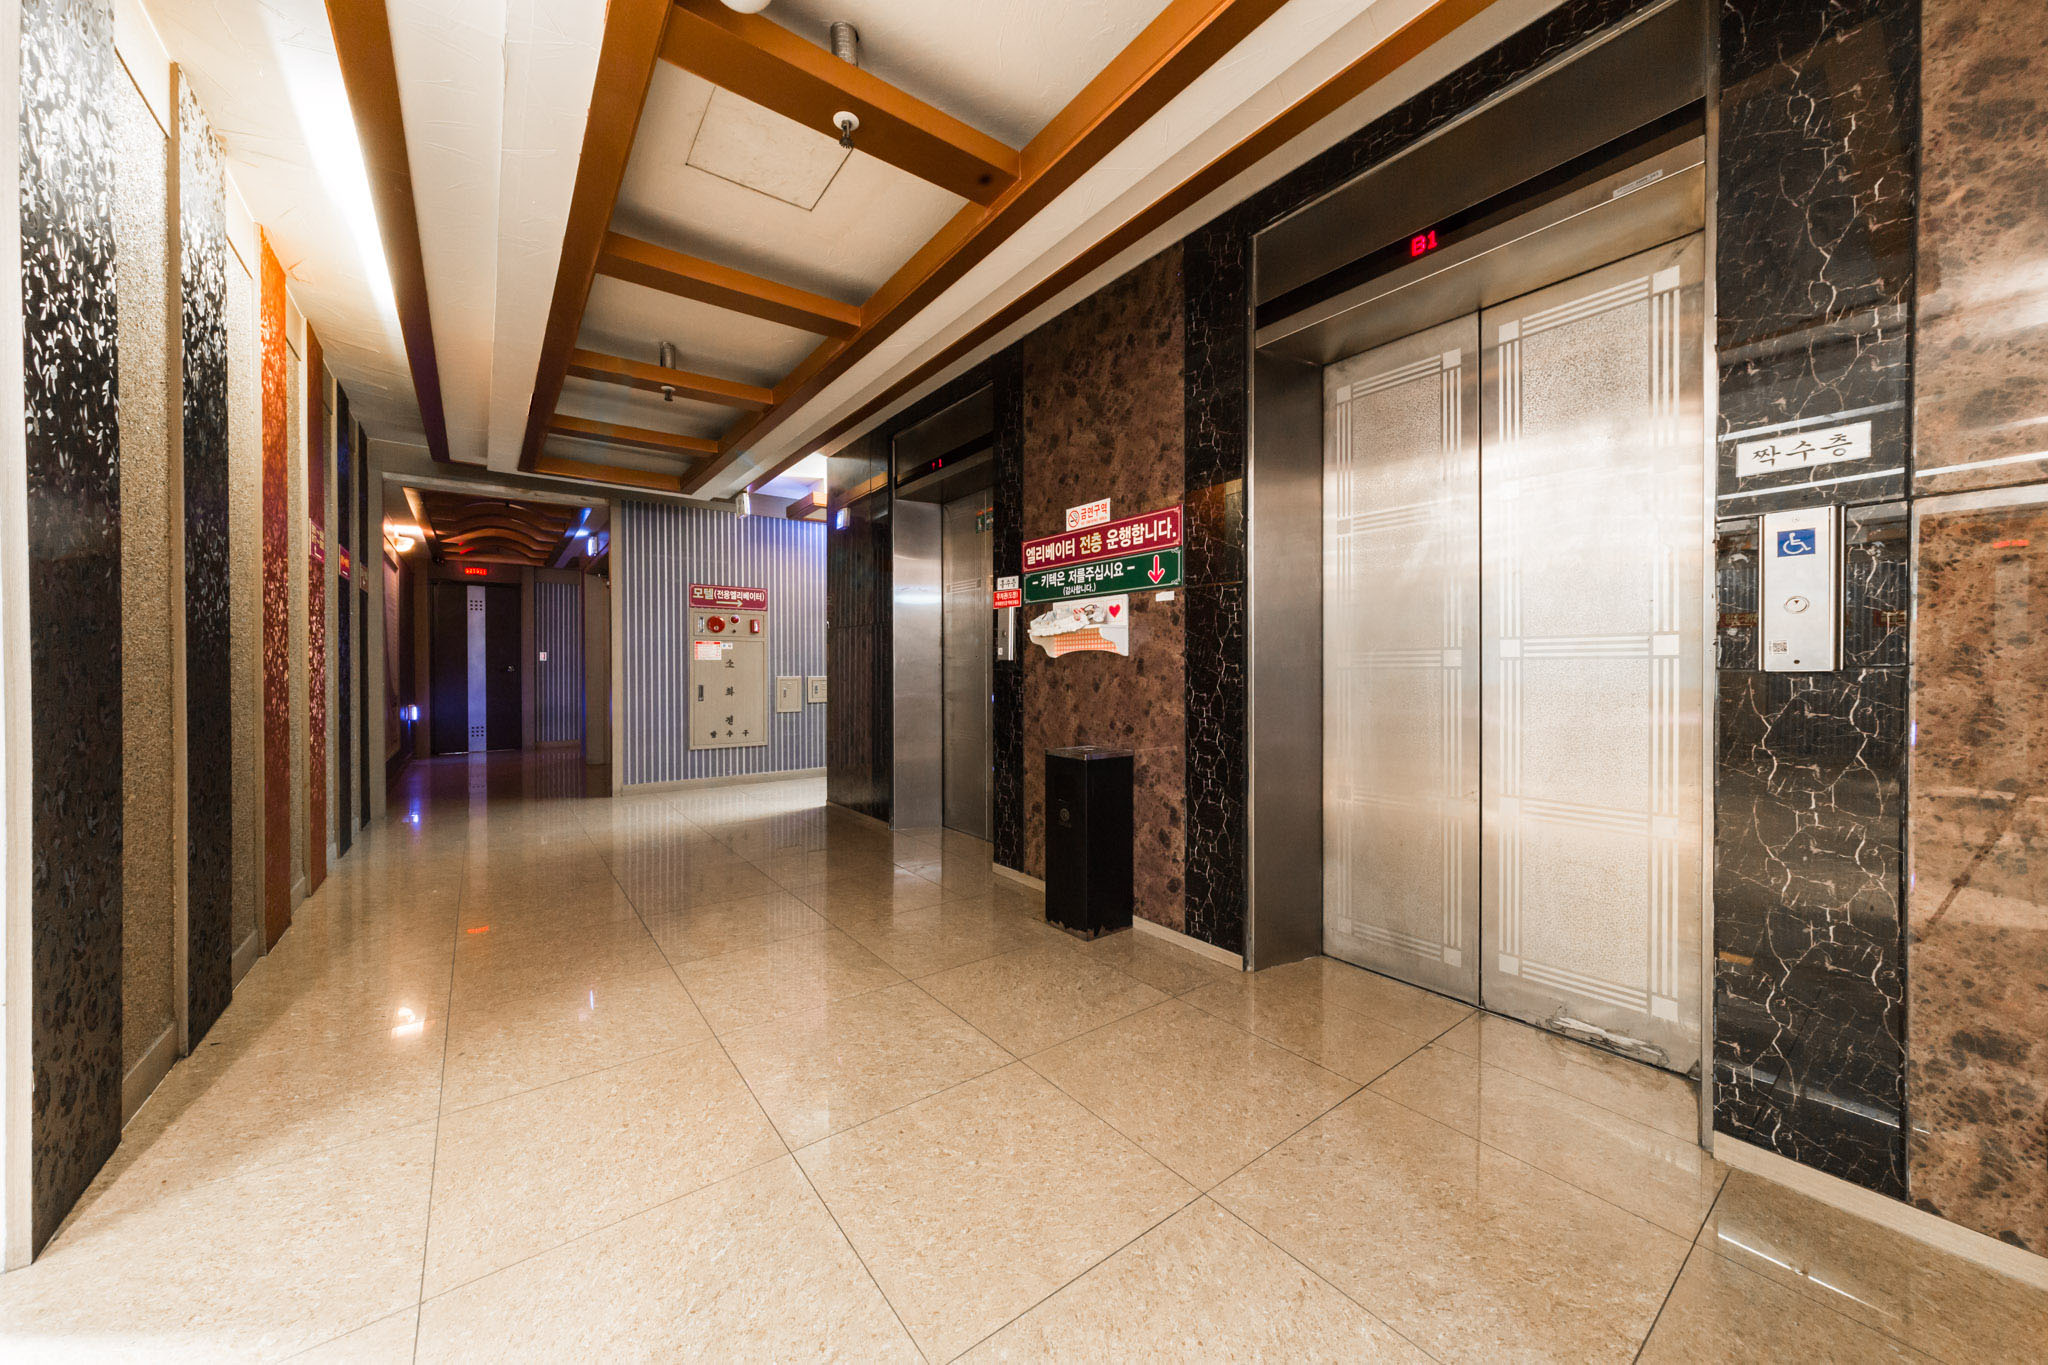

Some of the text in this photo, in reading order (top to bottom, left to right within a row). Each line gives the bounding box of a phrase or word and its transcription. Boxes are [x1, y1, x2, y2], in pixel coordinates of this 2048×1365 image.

[1411, 230, 1438, 257] B1
[1752, 432, 1853, 466] 짝수층
[1080, 501, 1108, 520] 금연구역
[1026, 516, 1177, 565] 엘리베이터 전층 운행합니다.
[1068, 562, 1124, 584] 저를주십시요
